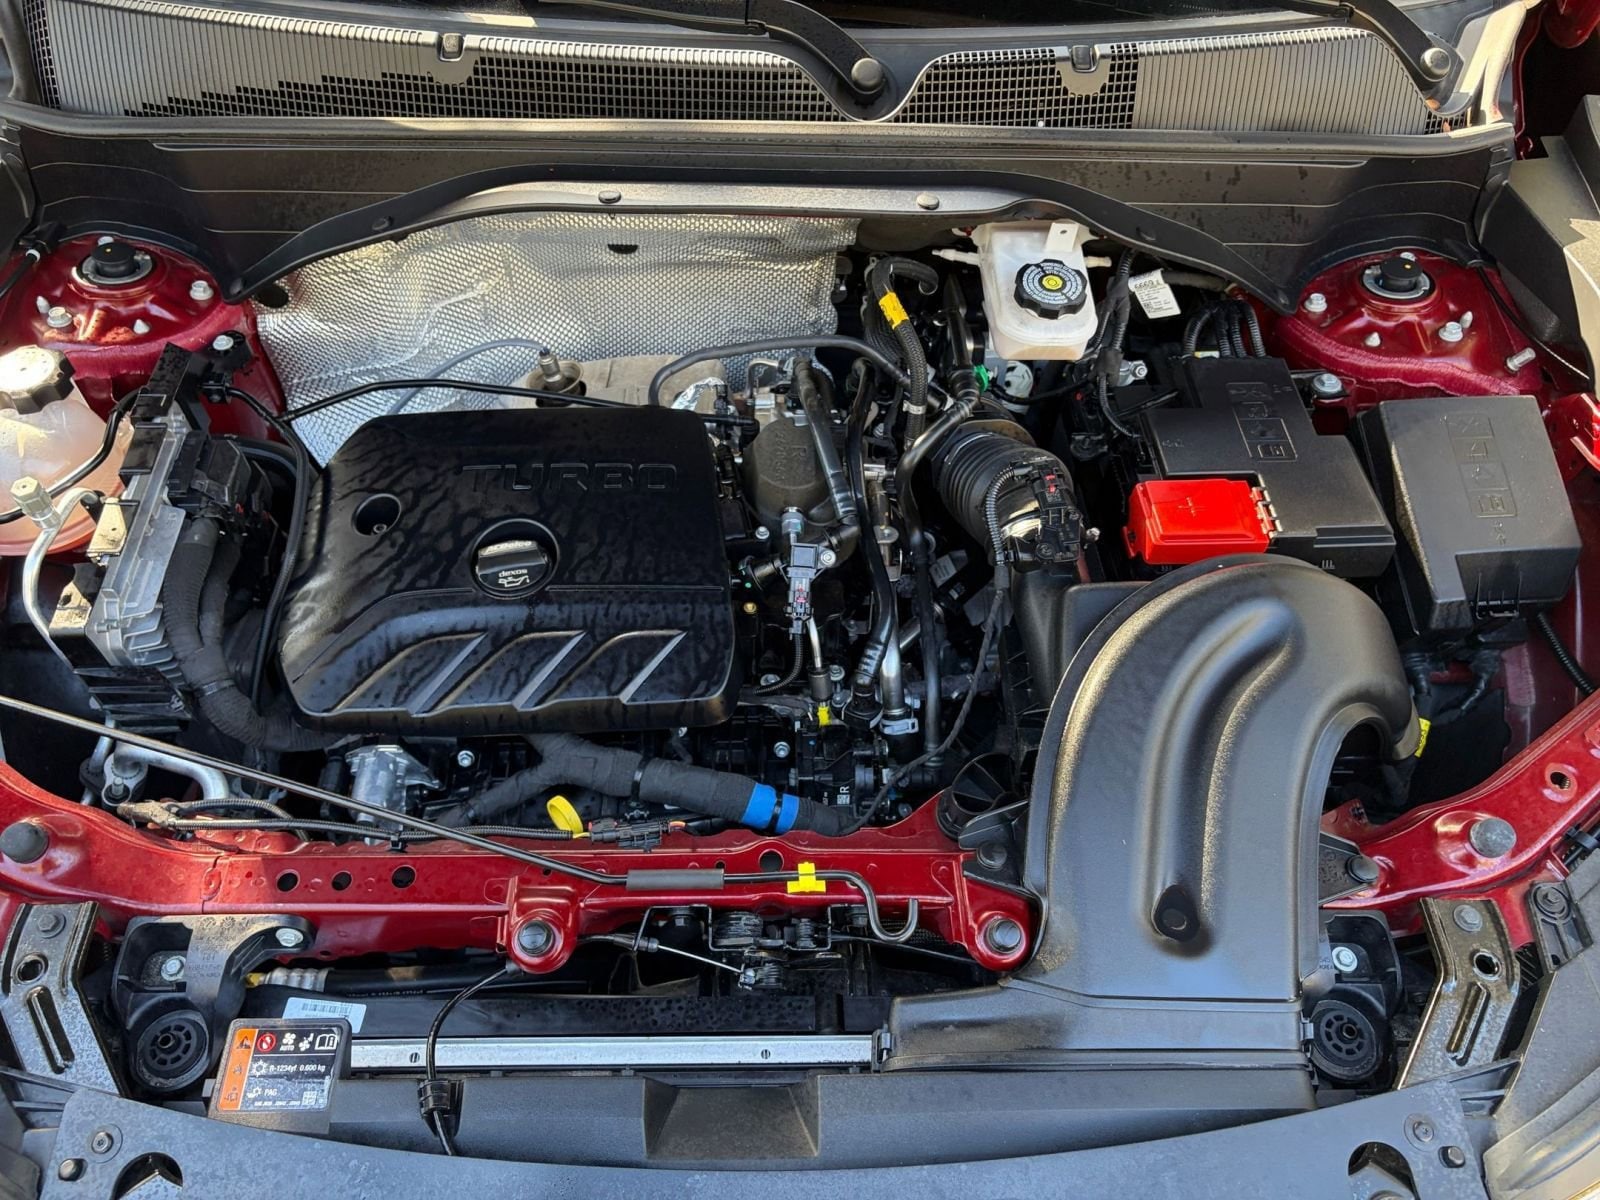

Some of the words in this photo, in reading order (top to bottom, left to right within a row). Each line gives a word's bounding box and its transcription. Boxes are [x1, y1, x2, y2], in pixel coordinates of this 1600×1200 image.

[461, 463, 678, 492] TURBO
[498, 568, 528, 578] dexos
[318, 1064, 326, 1073] kg
[264, 1088, 278, 1097] PAG
